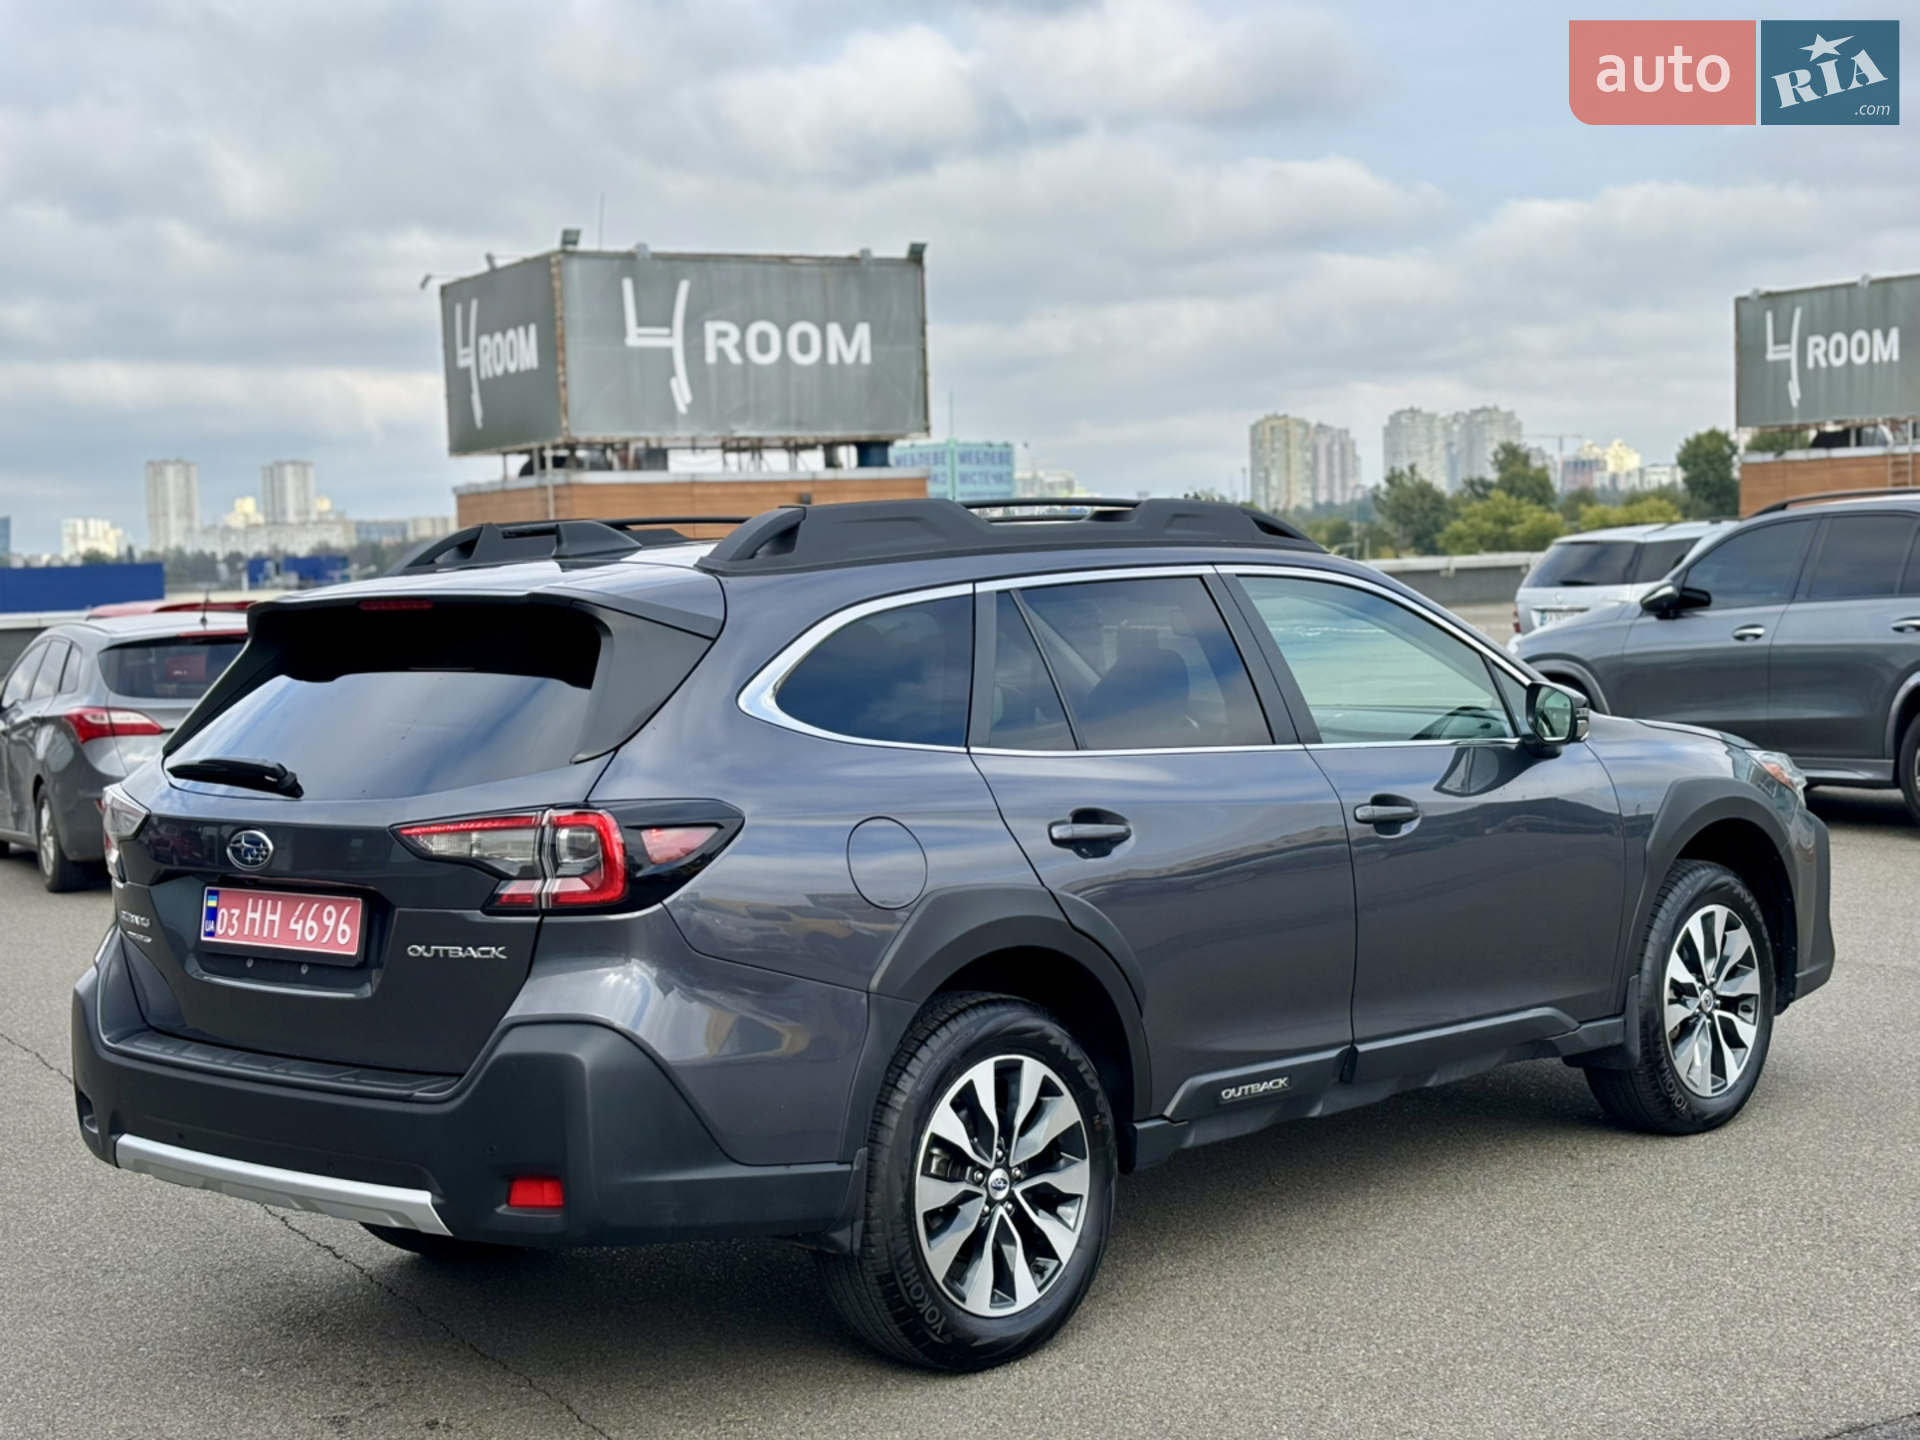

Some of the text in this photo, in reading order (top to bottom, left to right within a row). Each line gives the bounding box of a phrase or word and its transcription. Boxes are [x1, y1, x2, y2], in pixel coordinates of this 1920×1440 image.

[478, 322, 539, 380] ROOM
[704, 320, 872, 366] ROOM
[1806, 327, 1900, 370] ROOM
[204, 919, 216, 932] UA
[217, 898, 352, 945] 03 HH 4696
[406, 944, 508, 960] OUTBACK
[1220, 1075, 1289, 1100] OUTBACK
